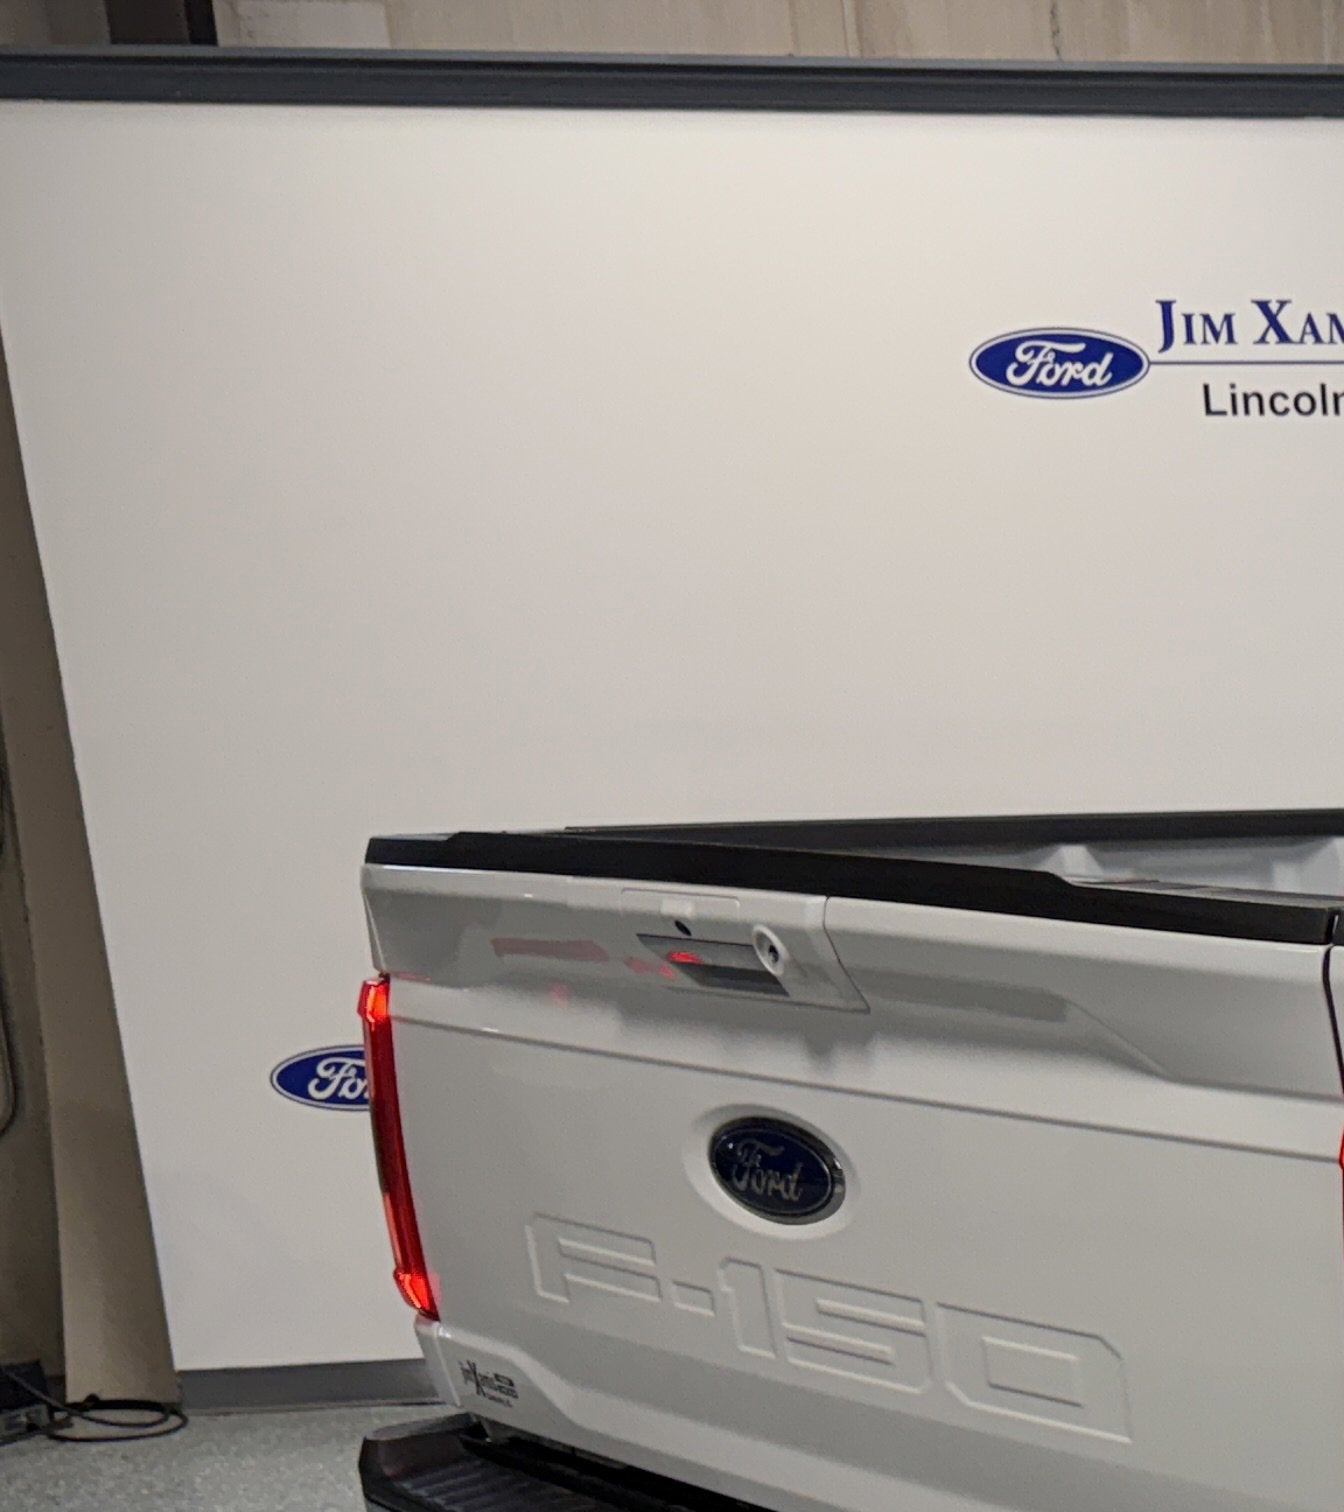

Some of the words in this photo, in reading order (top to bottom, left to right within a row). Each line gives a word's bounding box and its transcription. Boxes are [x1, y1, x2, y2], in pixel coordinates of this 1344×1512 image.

[1155, 300, 1237, 354] JIM
[1004, 339, 1113, 389] Ford
[731, 1138, 804, 1201] Ford
[525, 1211, 1133, 1445] F-150
